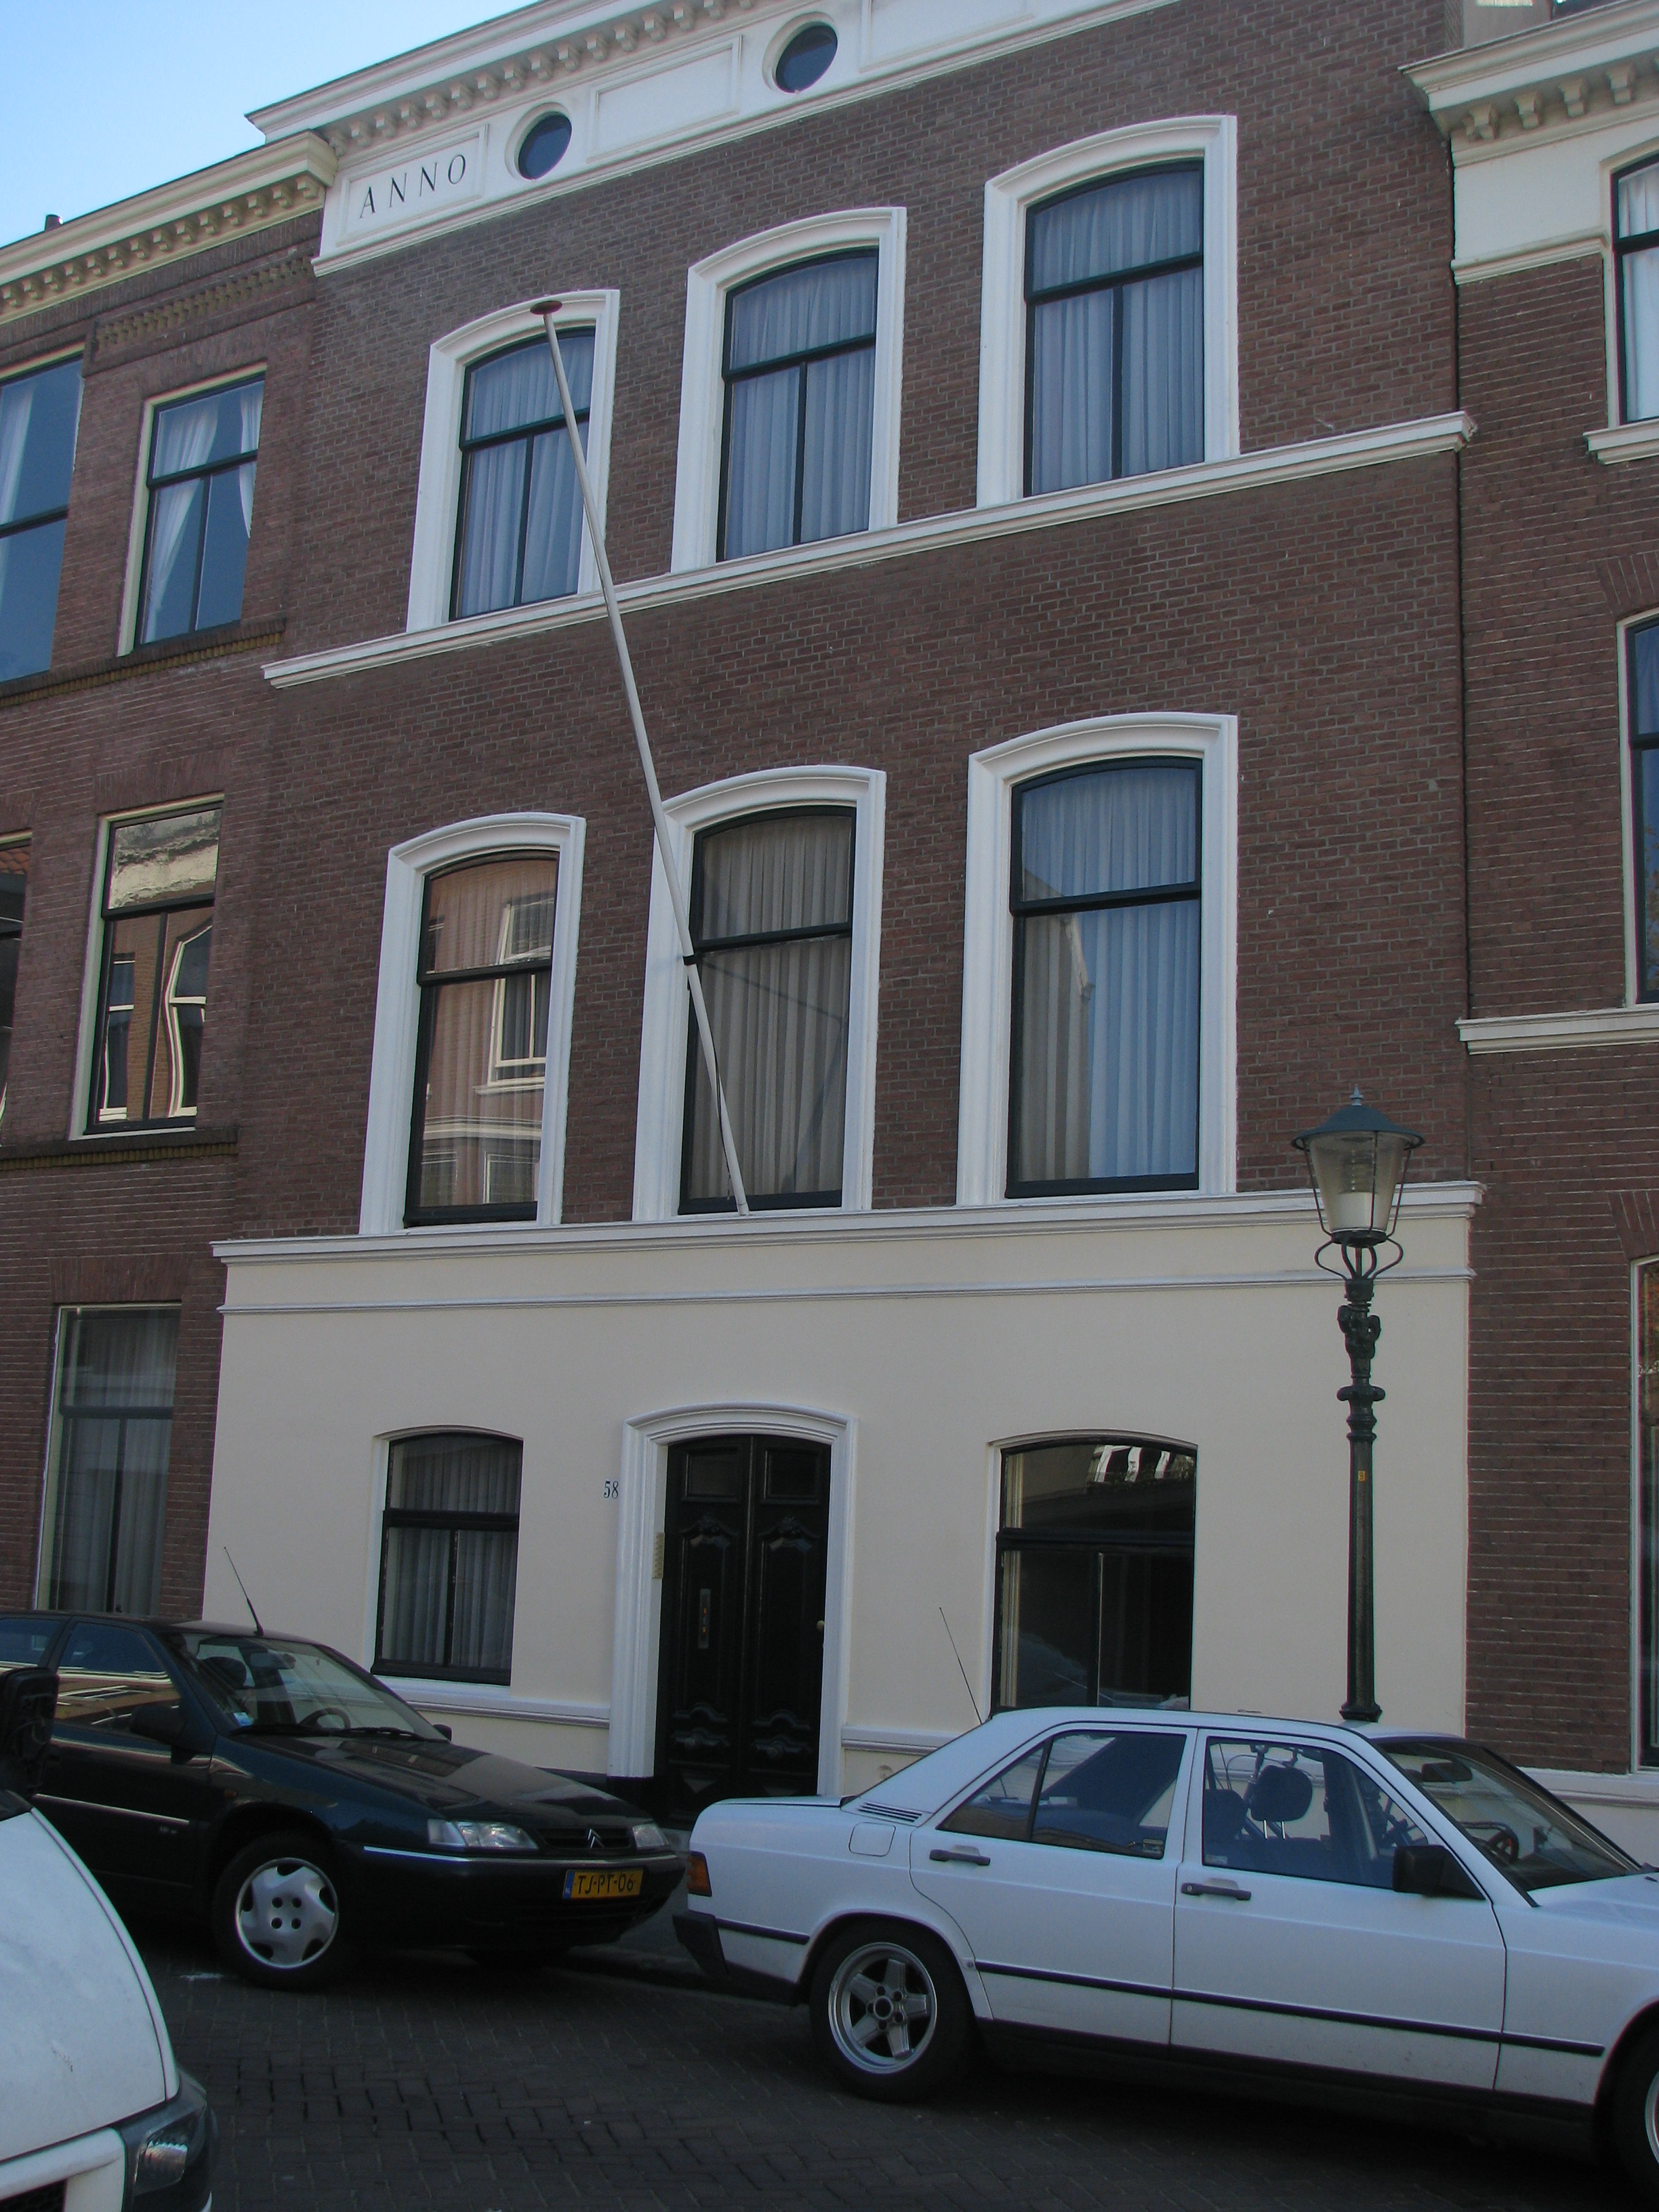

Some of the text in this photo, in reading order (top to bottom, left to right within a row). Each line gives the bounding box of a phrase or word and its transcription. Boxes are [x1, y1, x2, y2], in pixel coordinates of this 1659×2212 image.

[359, 154, 466, 219] ANNO
[603, 1480, 619, 1499] 58
[577, 1872, 634, 1894] TJ-PT-06
